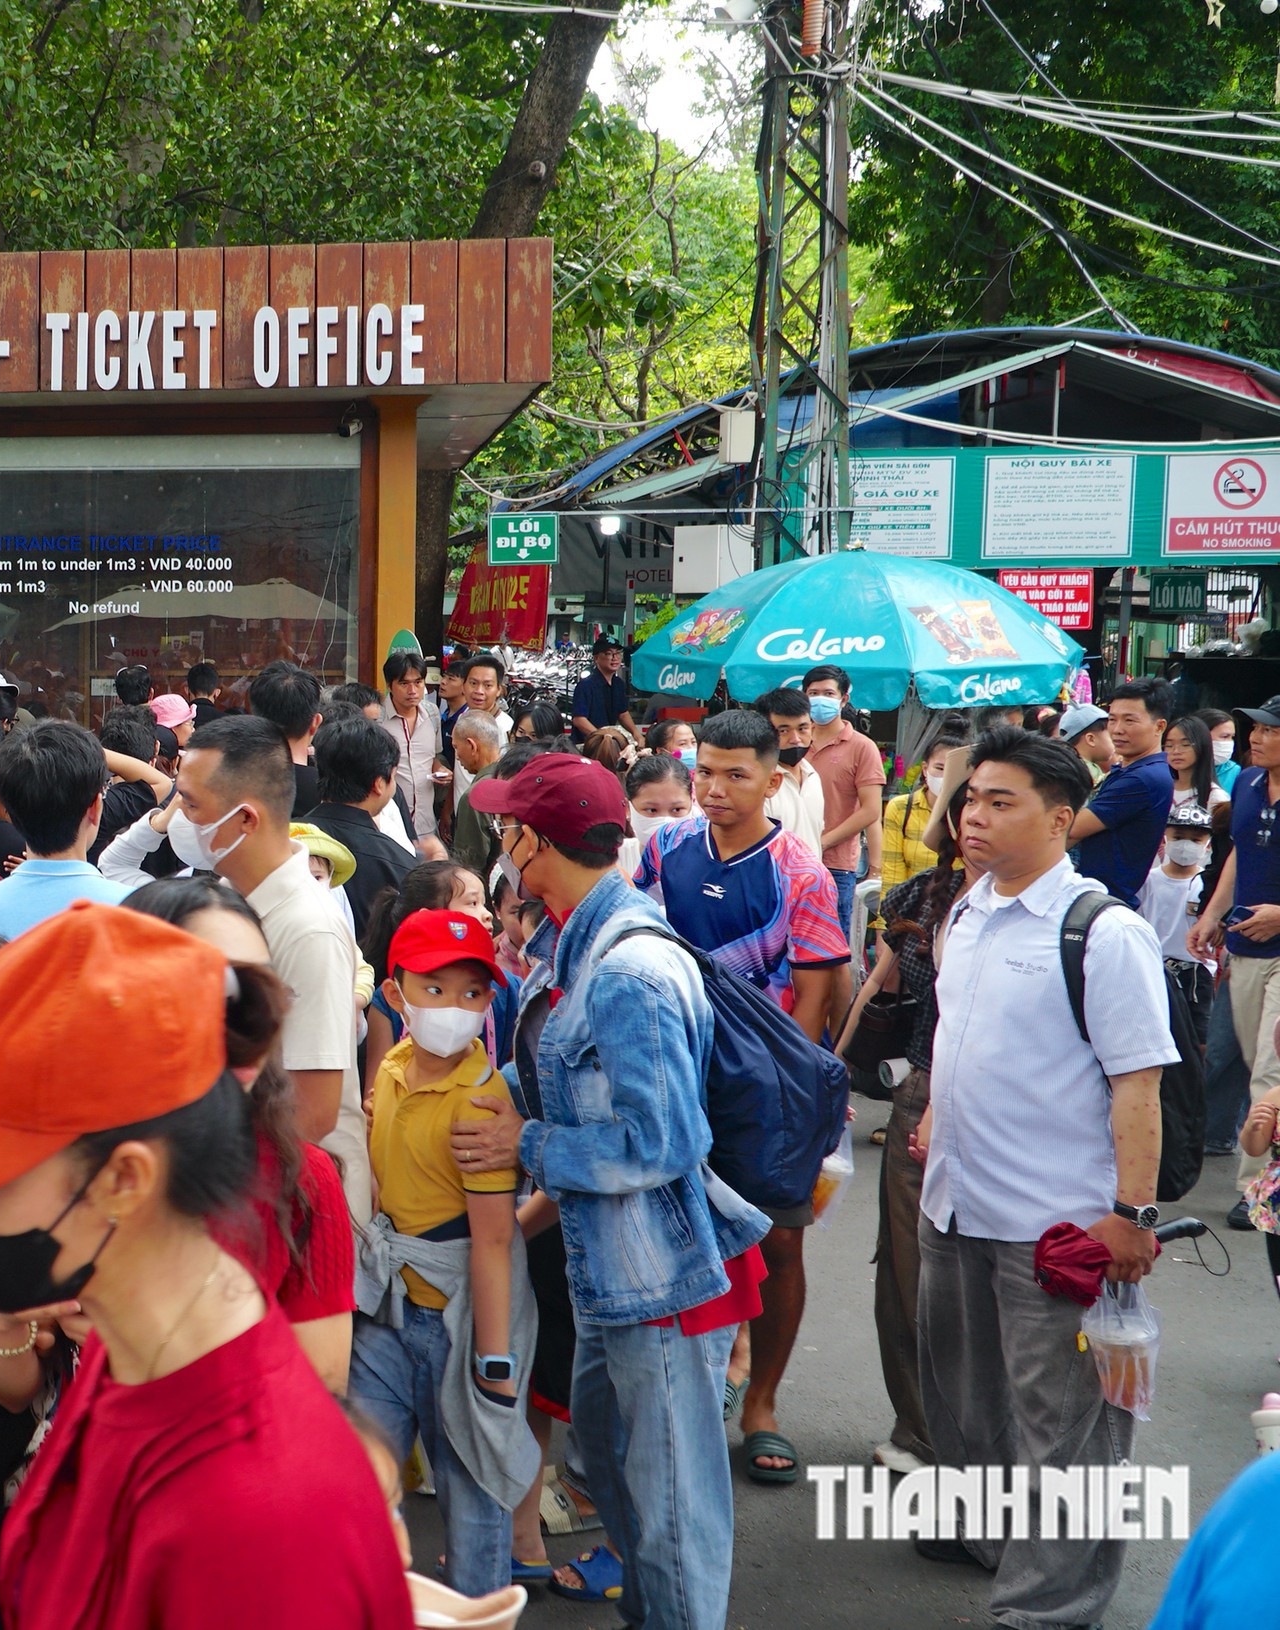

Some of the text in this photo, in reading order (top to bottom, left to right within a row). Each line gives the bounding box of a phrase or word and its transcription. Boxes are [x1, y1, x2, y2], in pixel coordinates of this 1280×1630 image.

[46, 309, 217, 391] TICKET
[253, 303, 425, 388] OFFICE
[1011, 459, 1035, 469] NỘI
[1071, 459, 1092, 467] BÃI
[864, 489, 888, 498] GIÁ
[893, 488, 919, 498] GIỮ
[508, 518, 540, 533] LỐI
[1175, 520, 1209, 536] CẤM
[1213, 519, 1244, 535] HÚT
[88, 535, 158, 551] TICKET
[163, 535, 222, 551] PRICE
[496, 534, 551, 549] ĐI BỘ
[1202, 537, 1272, 548] NO SMOKING
[17, 558, 37, 571] 1m
[42, 559, 56, 571] to
[61, 558, 102, 571] under
[106, 558, 136, 571] 1m3
[149, 558, 181, 571] VND
[185, 558, 232, 571] 40.000
[16, 580, 46, 593] 1m3
[151, 580, 182, 593] VND
[187, 580, 233, 593] 60.000
[1003, 572, 1088, 587] YÊU CẦU QUÝ KHÁCH
[1028, 589, 1045, 600] VÀO
[1065, 590, 1075, 599] XE
[1155, 578, 1202, 608] LỐI VÀO
[69, 601, 140, 614] No refund
[756, 628, 885, 661] Celano
[658, 664, 696, 690] Celano
[960, 673, 1022, 703] Celano
[1178, 808, 1210, 825] BOY
